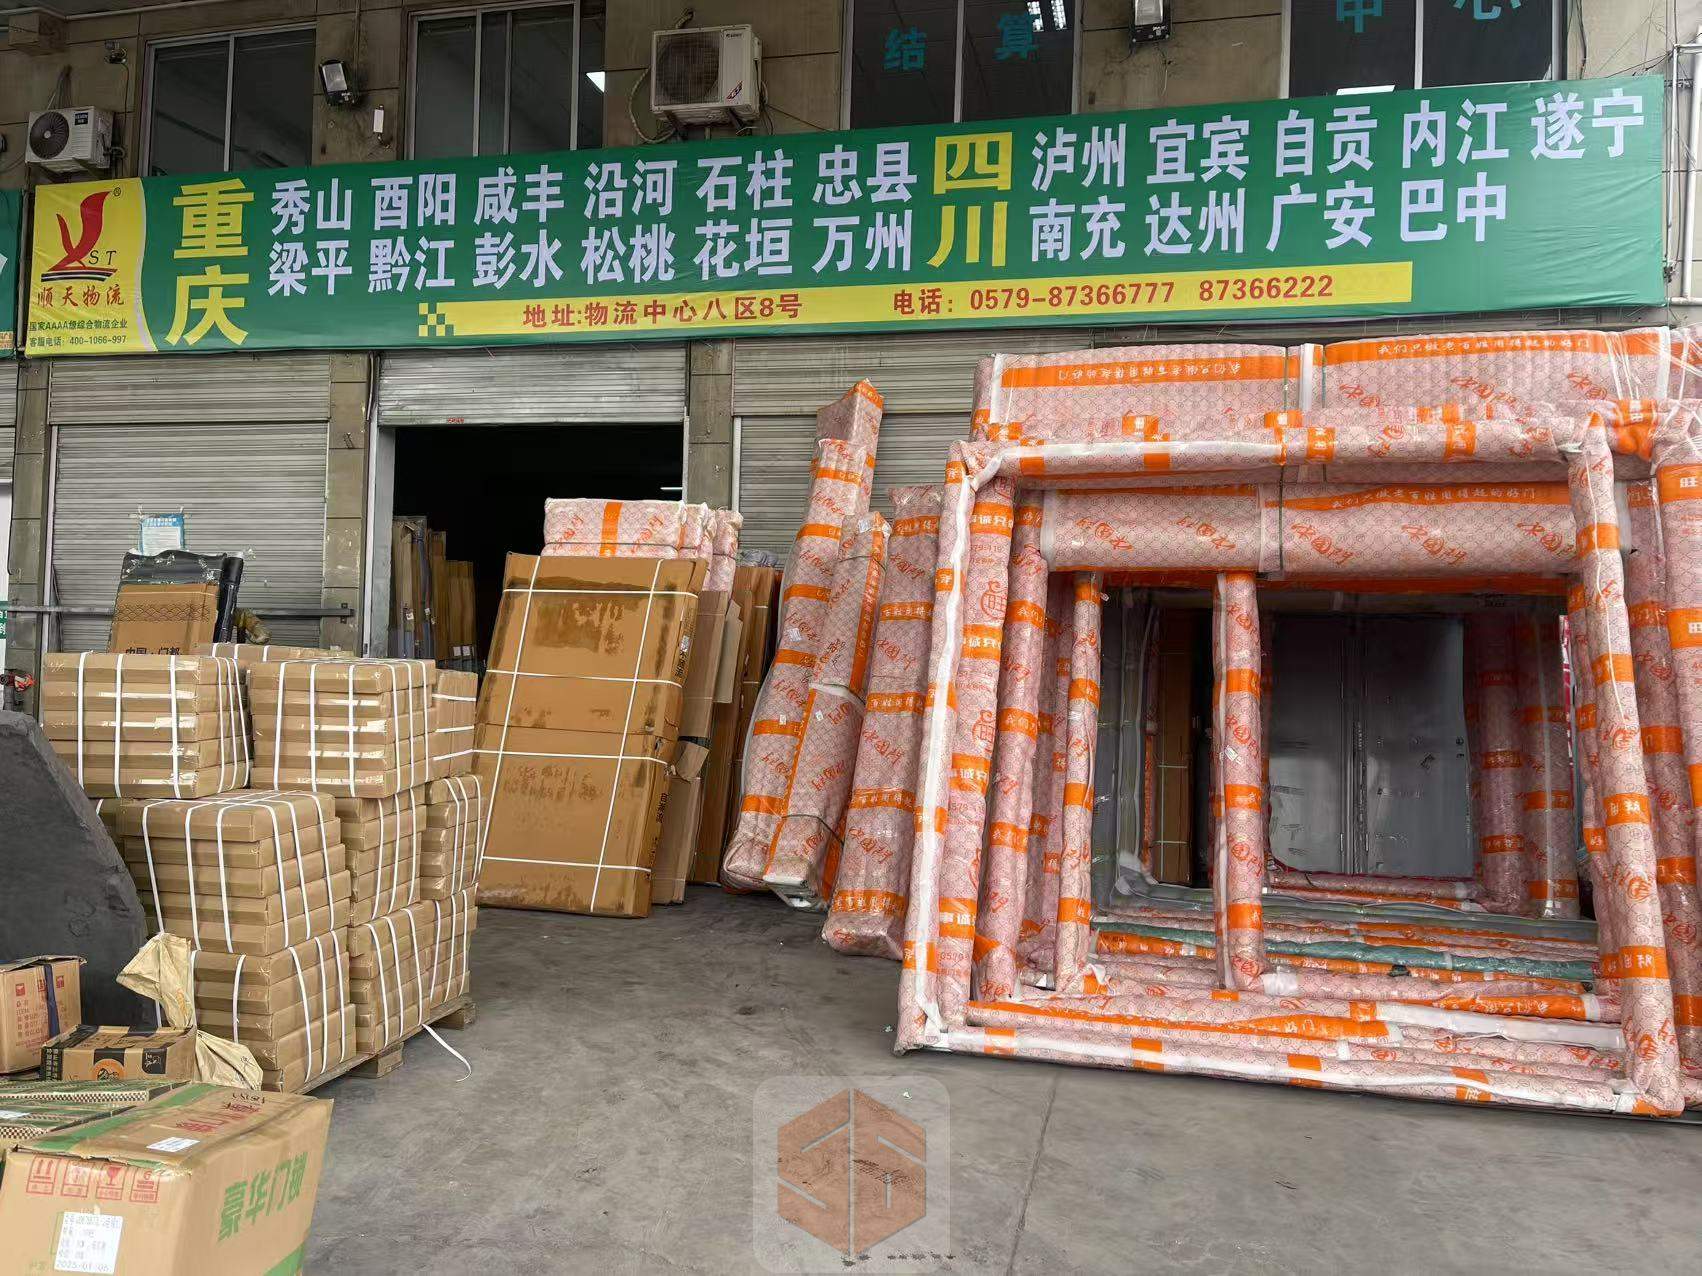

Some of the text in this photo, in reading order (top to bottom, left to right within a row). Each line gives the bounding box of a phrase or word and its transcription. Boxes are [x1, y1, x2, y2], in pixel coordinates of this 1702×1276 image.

[1031, 87, 1644, 192] 泸州 宜宾 自贡 内江 遂宁
[271, 141, 917, 235] 秀山 酉阳 咸丰 沿河 石柱 忠县
[926, 131, 1013, 268] 四川
[1028, 171, 1507, 262] 南充 达州 广安 巴中
[37, 283, 125, 308] 顺天物流
[164, 178, 256, 346] 重庆
[267, 210, 913, 297] 梁平 黔江 彭水 松桃 花垣 万州
[969, 281, 1176, 311] 0579-87366777
[1199, 275, 1335, 303] 87366222
